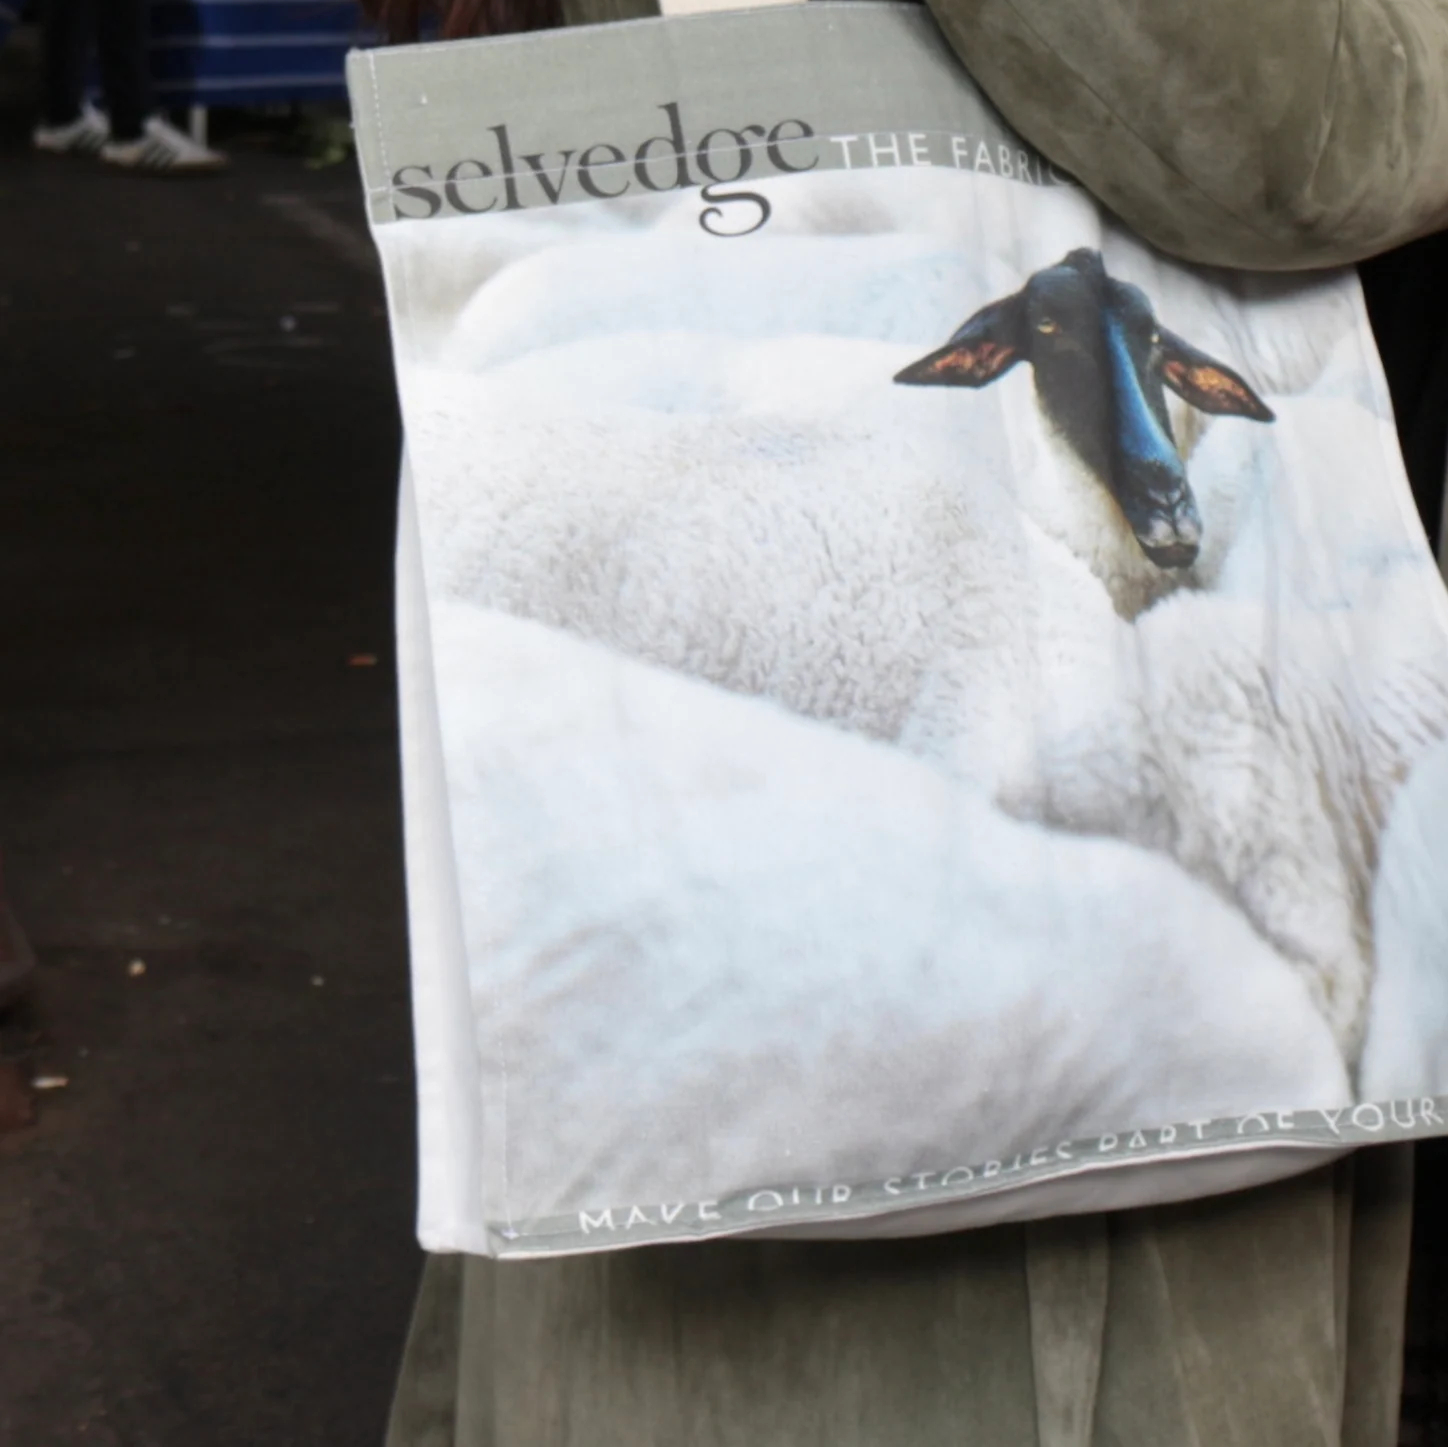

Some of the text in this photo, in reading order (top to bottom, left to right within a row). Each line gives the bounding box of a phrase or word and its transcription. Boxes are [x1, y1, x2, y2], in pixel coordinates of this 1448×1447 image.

[392, 102, 819, 238] selvedge
[830, 131, 932, 171] THE
[1320, 1097, 1444, 1135] YOUR
